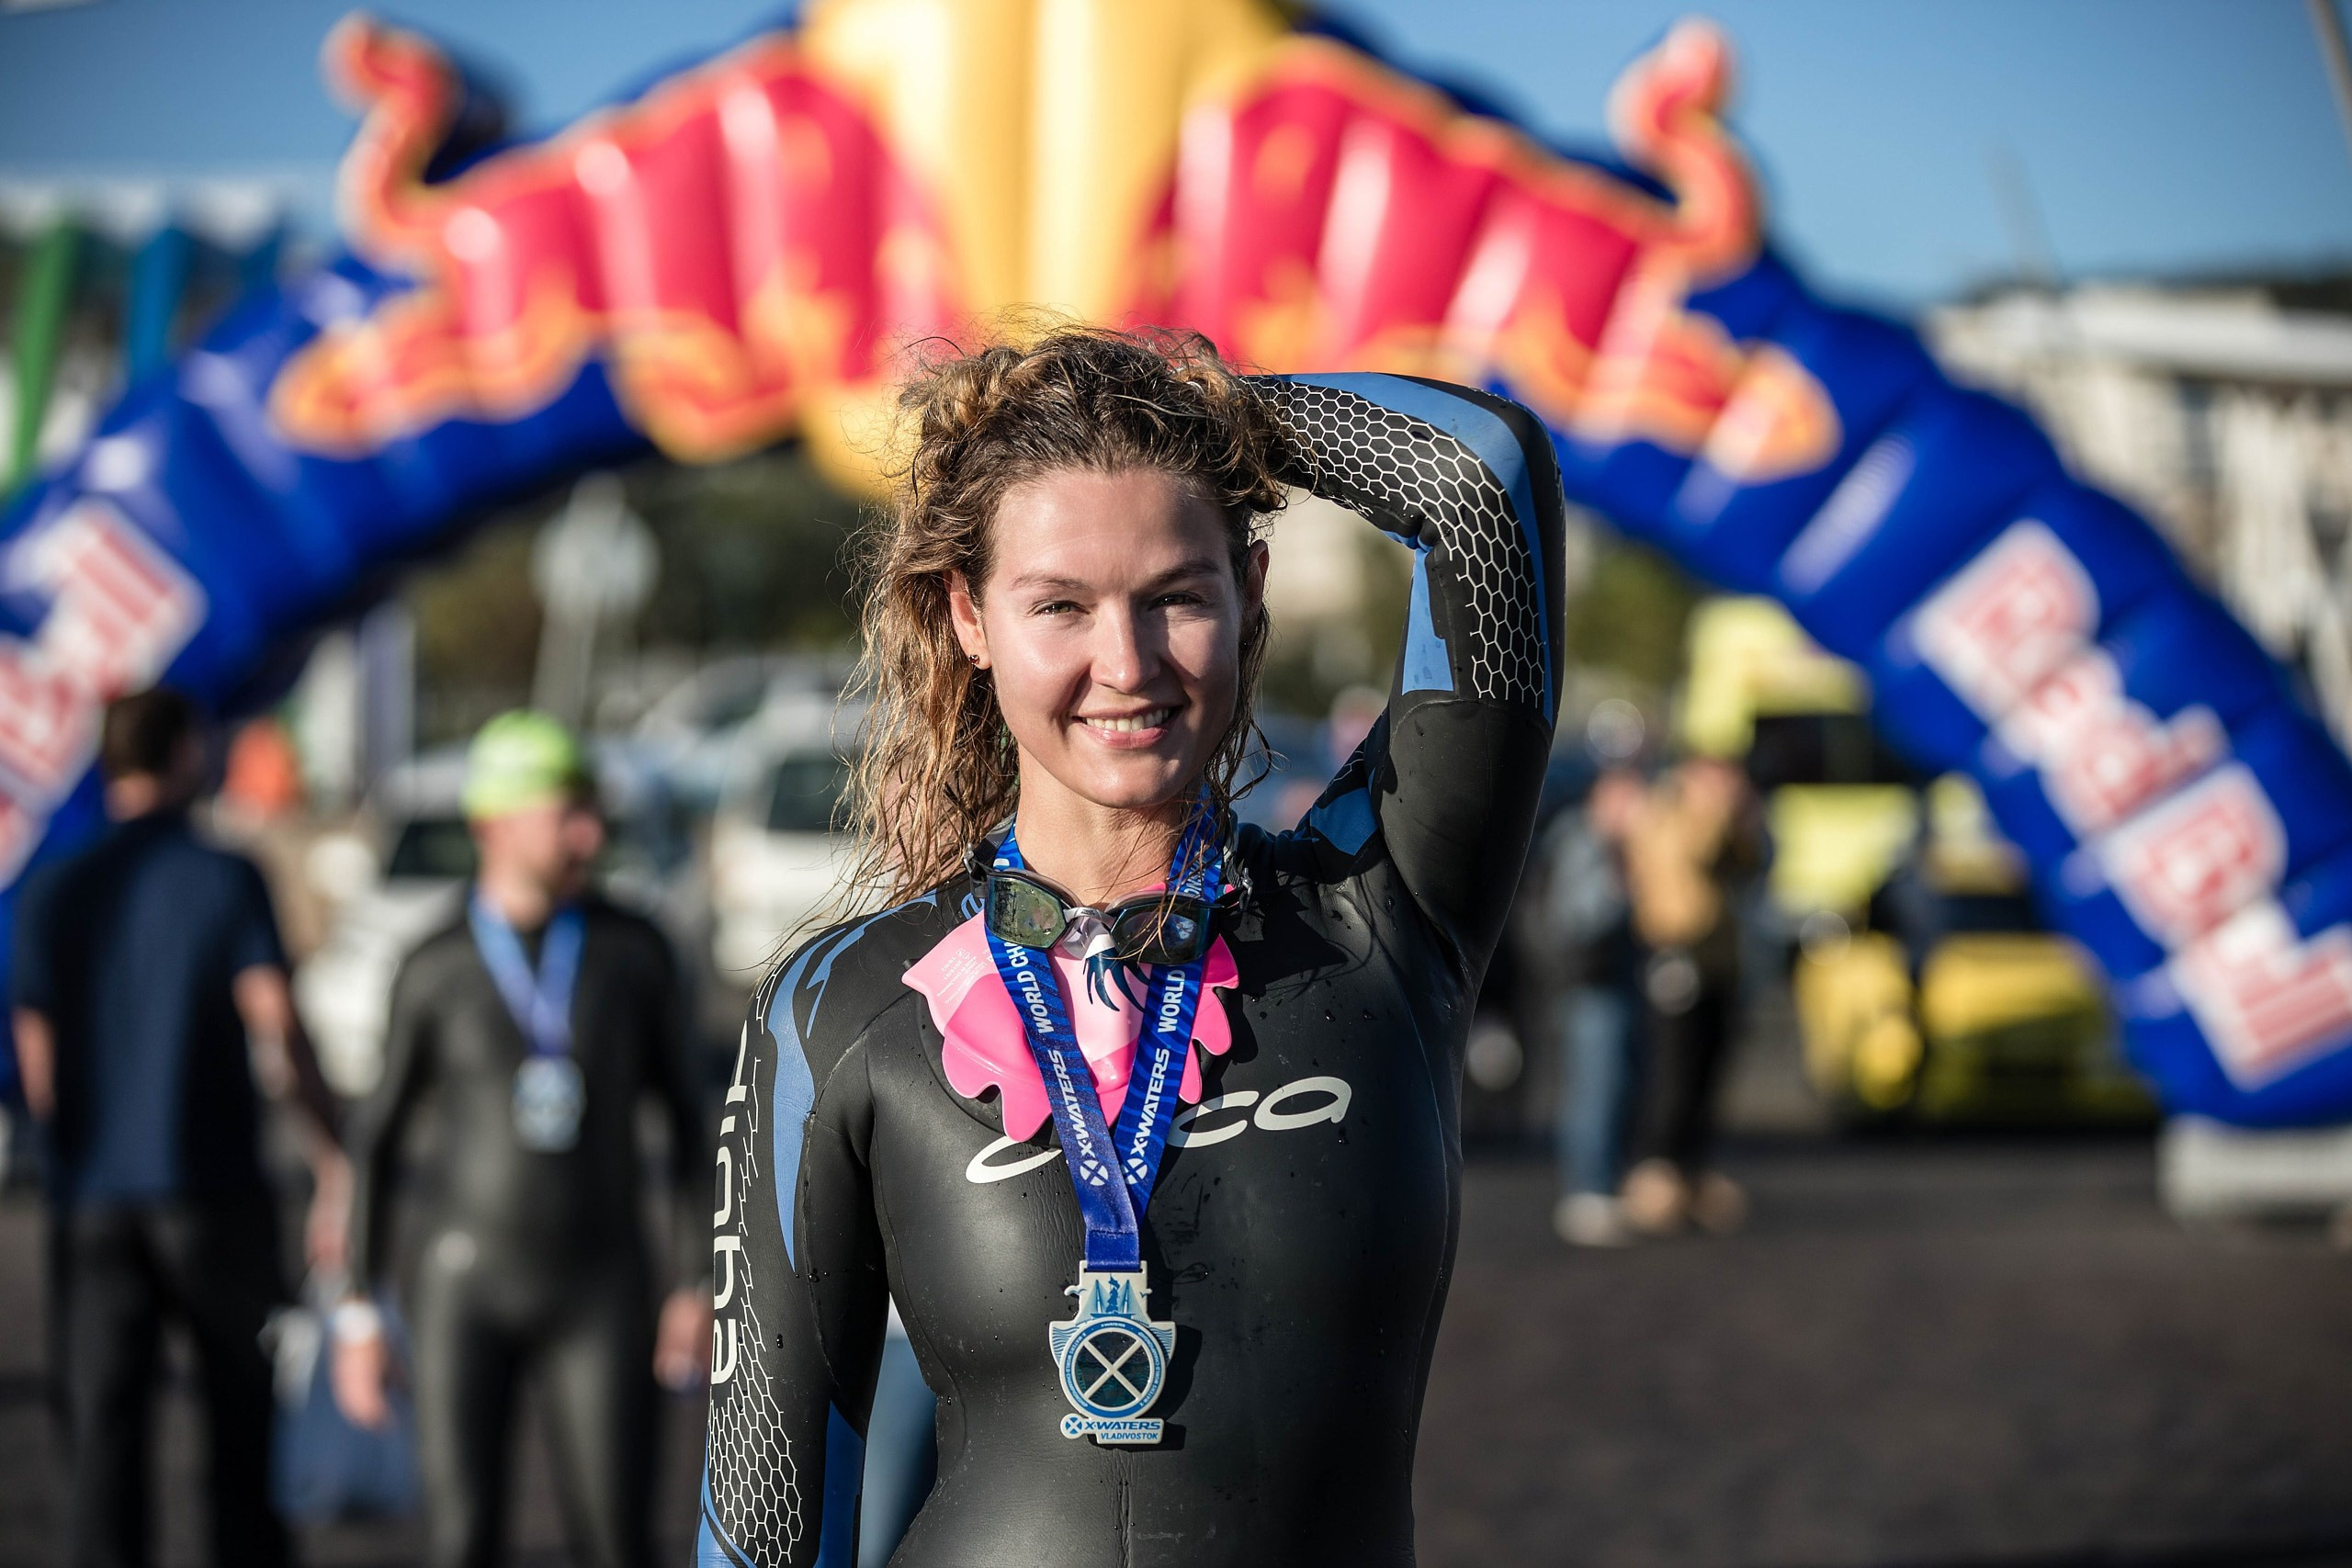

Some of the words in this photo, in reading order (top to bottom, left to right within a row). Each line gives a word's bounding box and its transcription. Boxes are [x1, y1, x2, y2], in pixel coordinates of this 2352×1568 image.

[1915, 520, 2228, 838] Red
[2104, 764, 2352, 1091] Bull
[1017, 969, 1055, 1034] WORLD
[1158, 969, 1186, 1033] WORLD
[966, 1077, 1352, 1183] oca
[1101, 1432, 1158, 1440] VLADIVOSTOK
